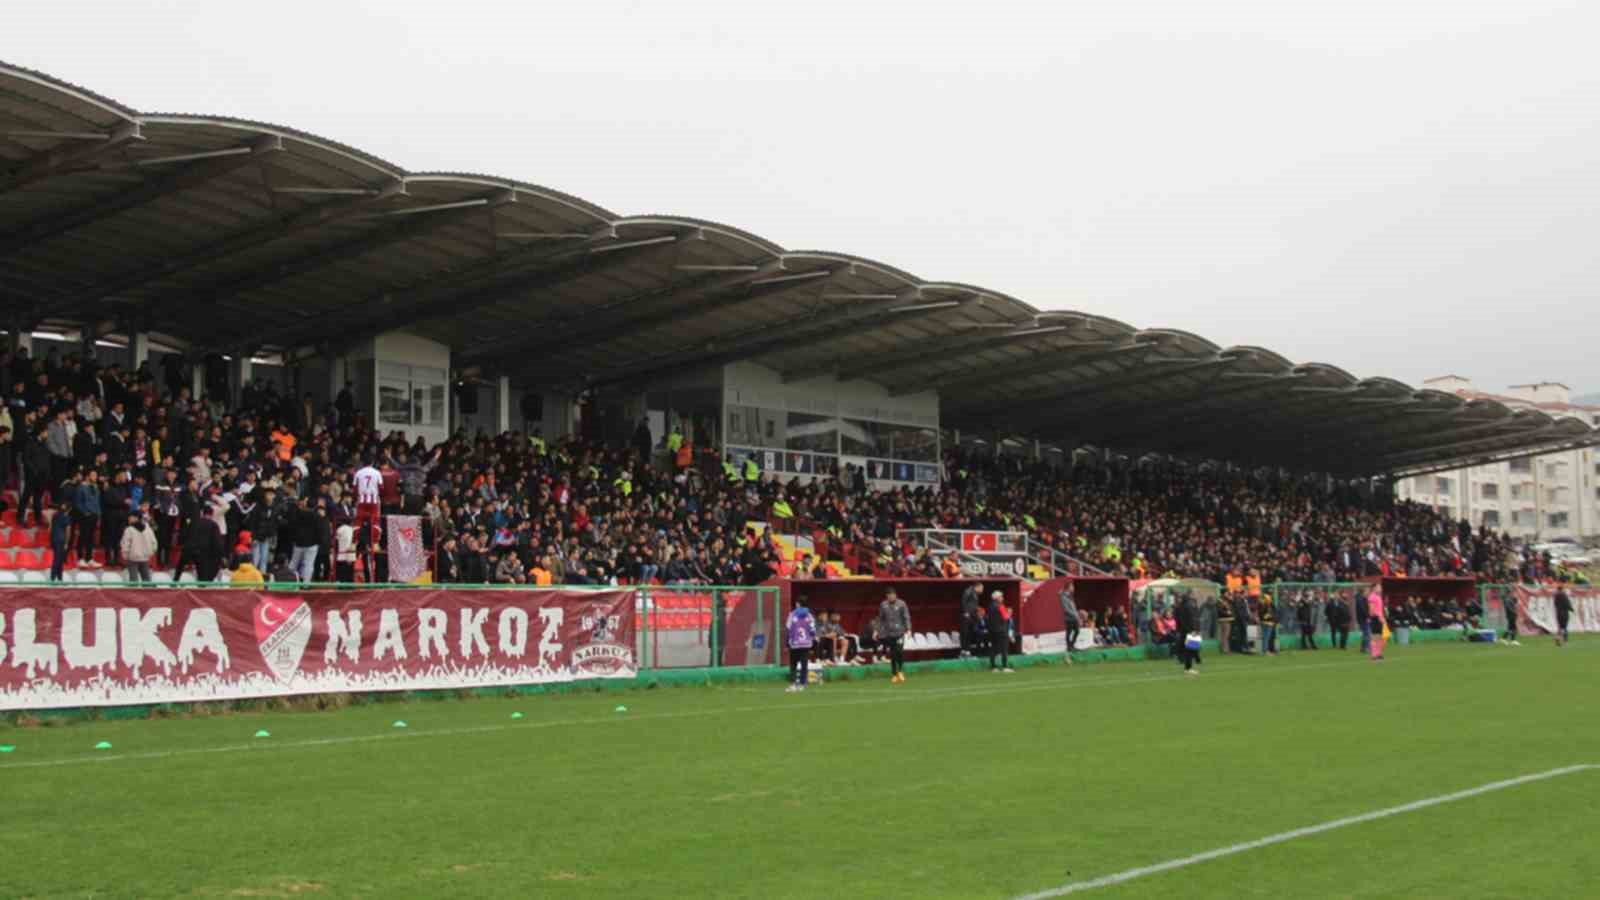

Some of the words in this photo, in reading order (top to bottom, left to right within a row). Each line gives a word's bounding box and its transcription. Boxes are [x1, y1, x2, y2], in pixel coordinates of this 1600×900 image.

[364, 475, 372, 488] 7
[0, 607, 230, 679] LUKA
[323, 606, 564, 666] NARKOZ
